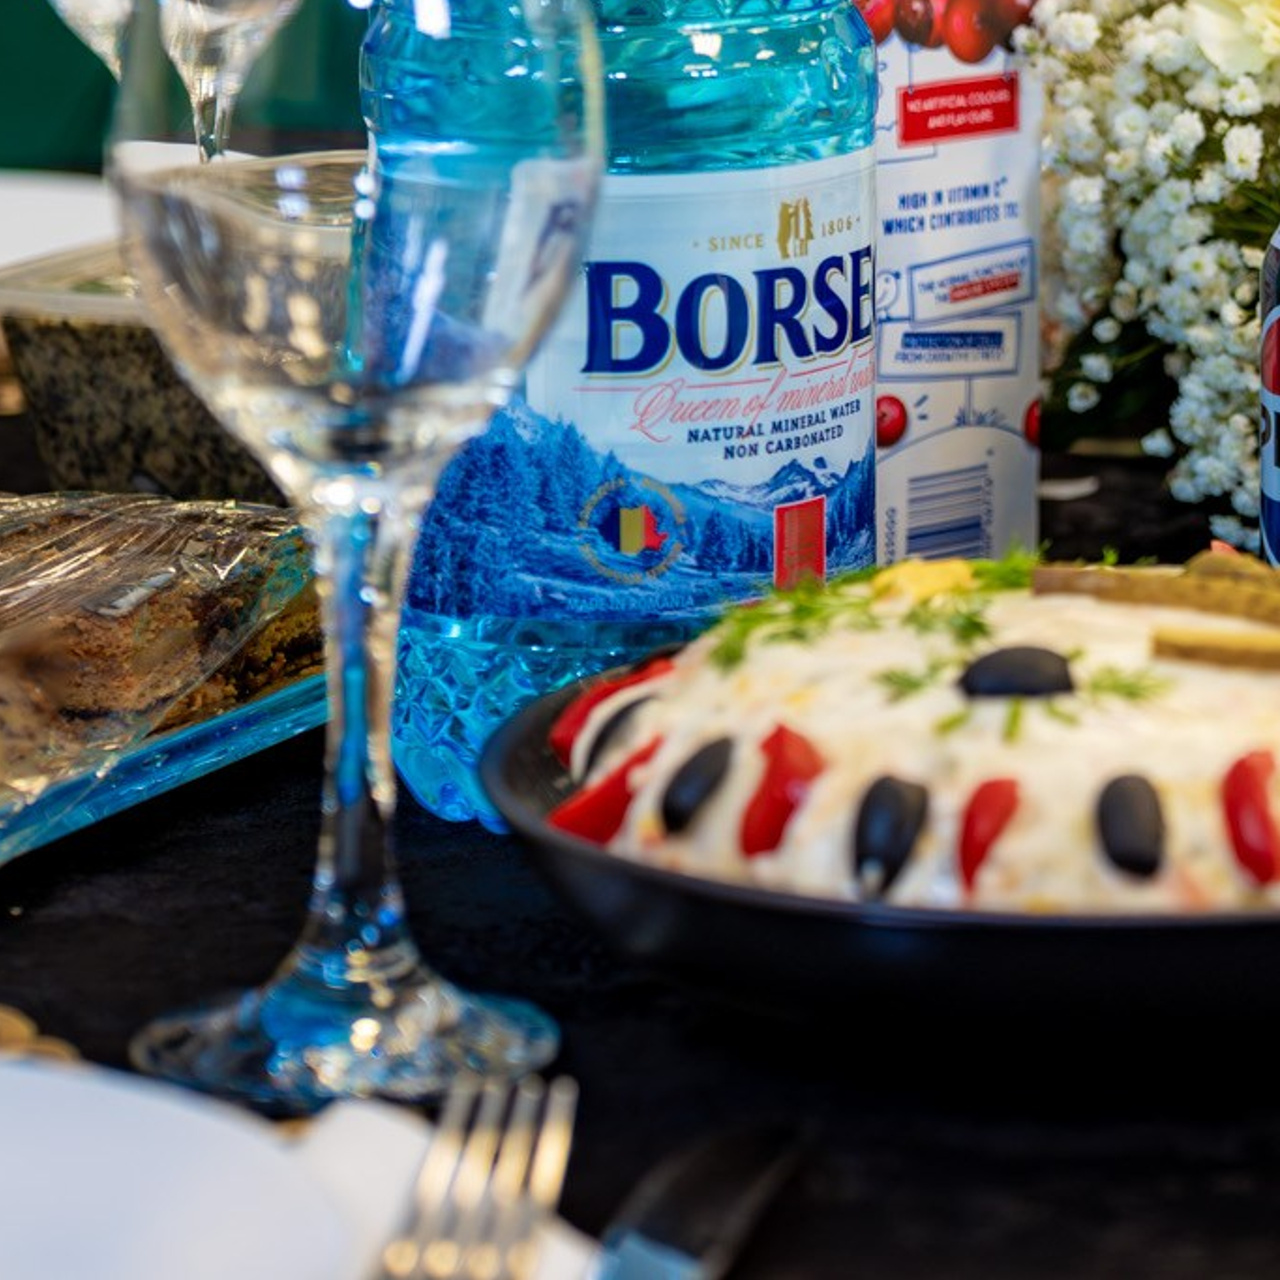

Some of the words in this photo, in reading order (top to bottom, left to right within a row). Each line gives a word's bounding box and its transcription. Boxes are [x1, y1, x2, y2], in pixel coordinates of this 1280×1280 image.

[898, 191, 927, 210] HIGH
[933, 190, 943, 205] IN
[948, 183, 990, 203] VITAMIN
[708, 233, 764, 252] SINCE
[821, 215, 853, 237] 1806
[882, 214, 925, 236] WHICH
[930, 205, 999, 230] CONTRIBUTES
[580, 245, 875, 373] BORSE
[630, 377, 740, 443] Queen
[740, 368, 788, 440] of
[775, 348, 858, 413] mineral
[687, 423, 765, 443] NATURAL
[770, 410, 826, 434] MINERAL
[829, 398, 861, 420] WATER
[723, 442, 759, 460] NON
[765, 424, 844, 455] CARBONATED
